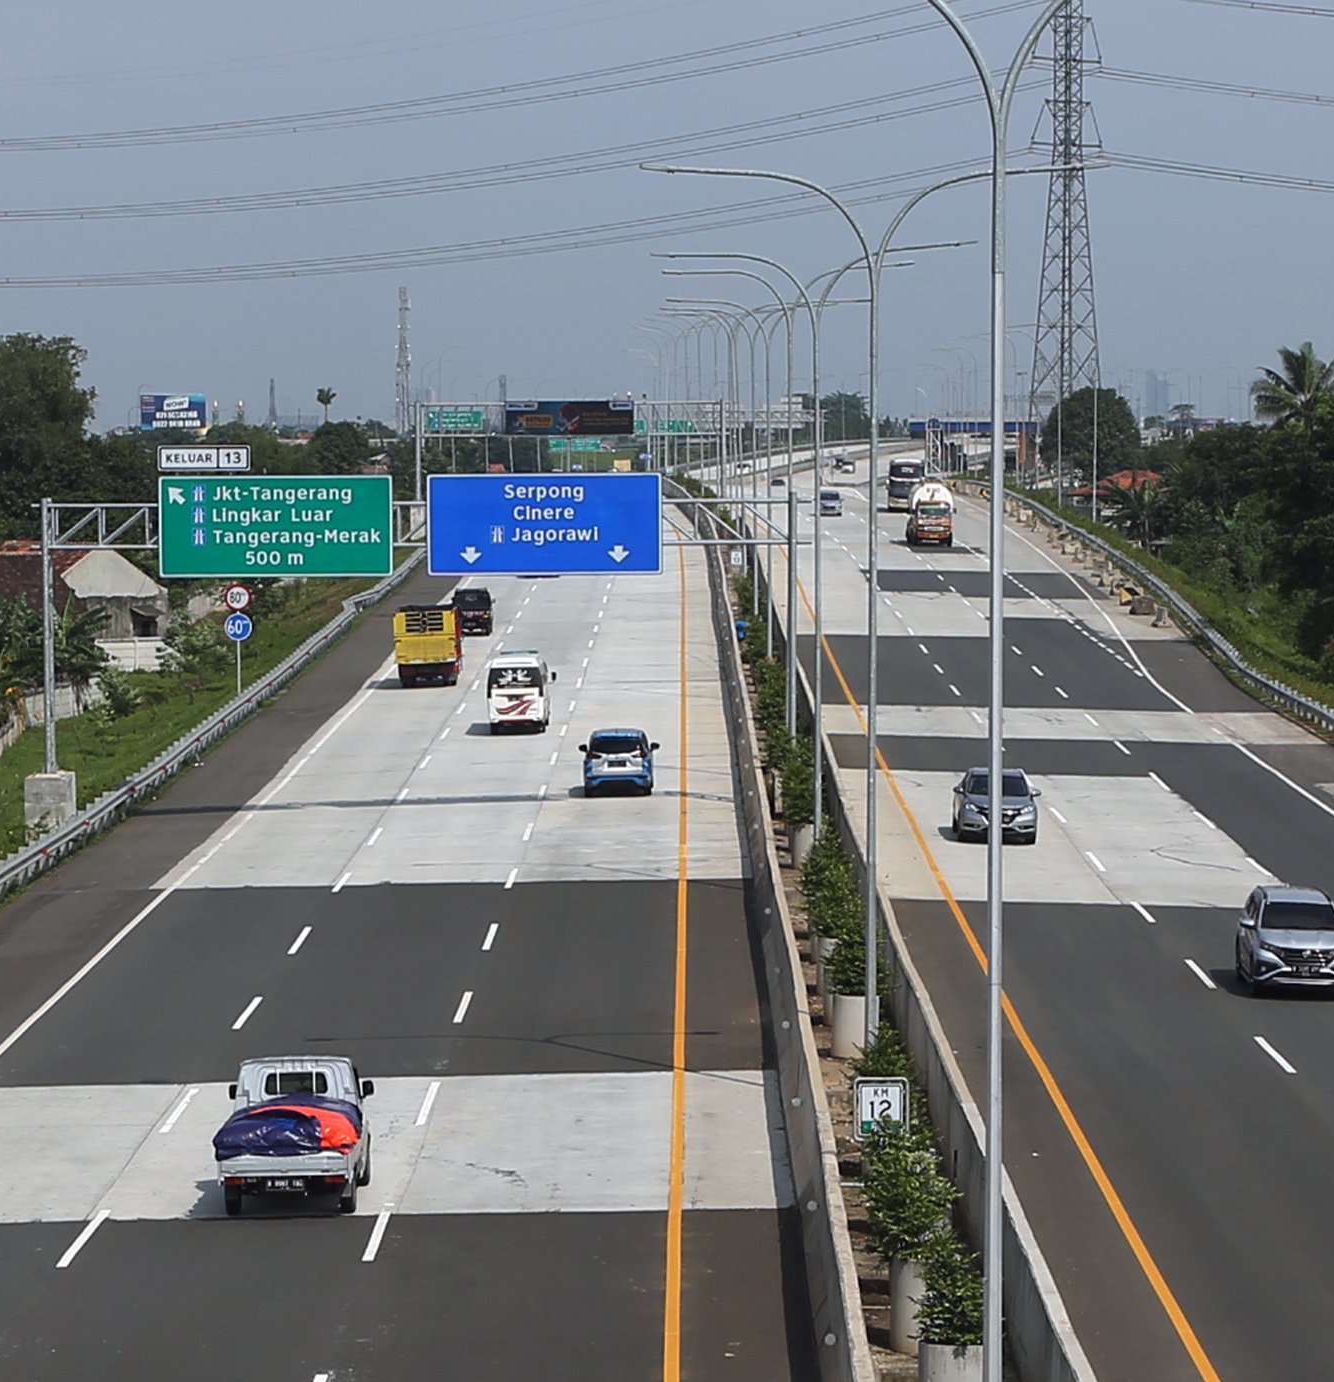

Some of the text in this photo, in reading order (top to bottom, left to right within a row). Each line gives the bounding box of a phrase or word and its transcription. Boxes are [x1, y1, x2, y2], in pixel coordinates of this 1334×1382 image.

[166, 450, 242, 464] KELUAR 13
[212, 486, 352, 504] Jkt-Tangerang
[504, 484, 585, 502] Serpong
[212, 507, 334, 526] Lingkar Luar
[513, 505, 575, 520] Cinere
[213, 528, 382, 548] Tangerang-Merak
[511, 526, 599, 545] Jagorawi
[245, 551, 304, 565] 500 m
[227, 620, 243, 635] 60
[873, 1088, 889, 1097] KM
[869, 1099, 892, 1120] 12
